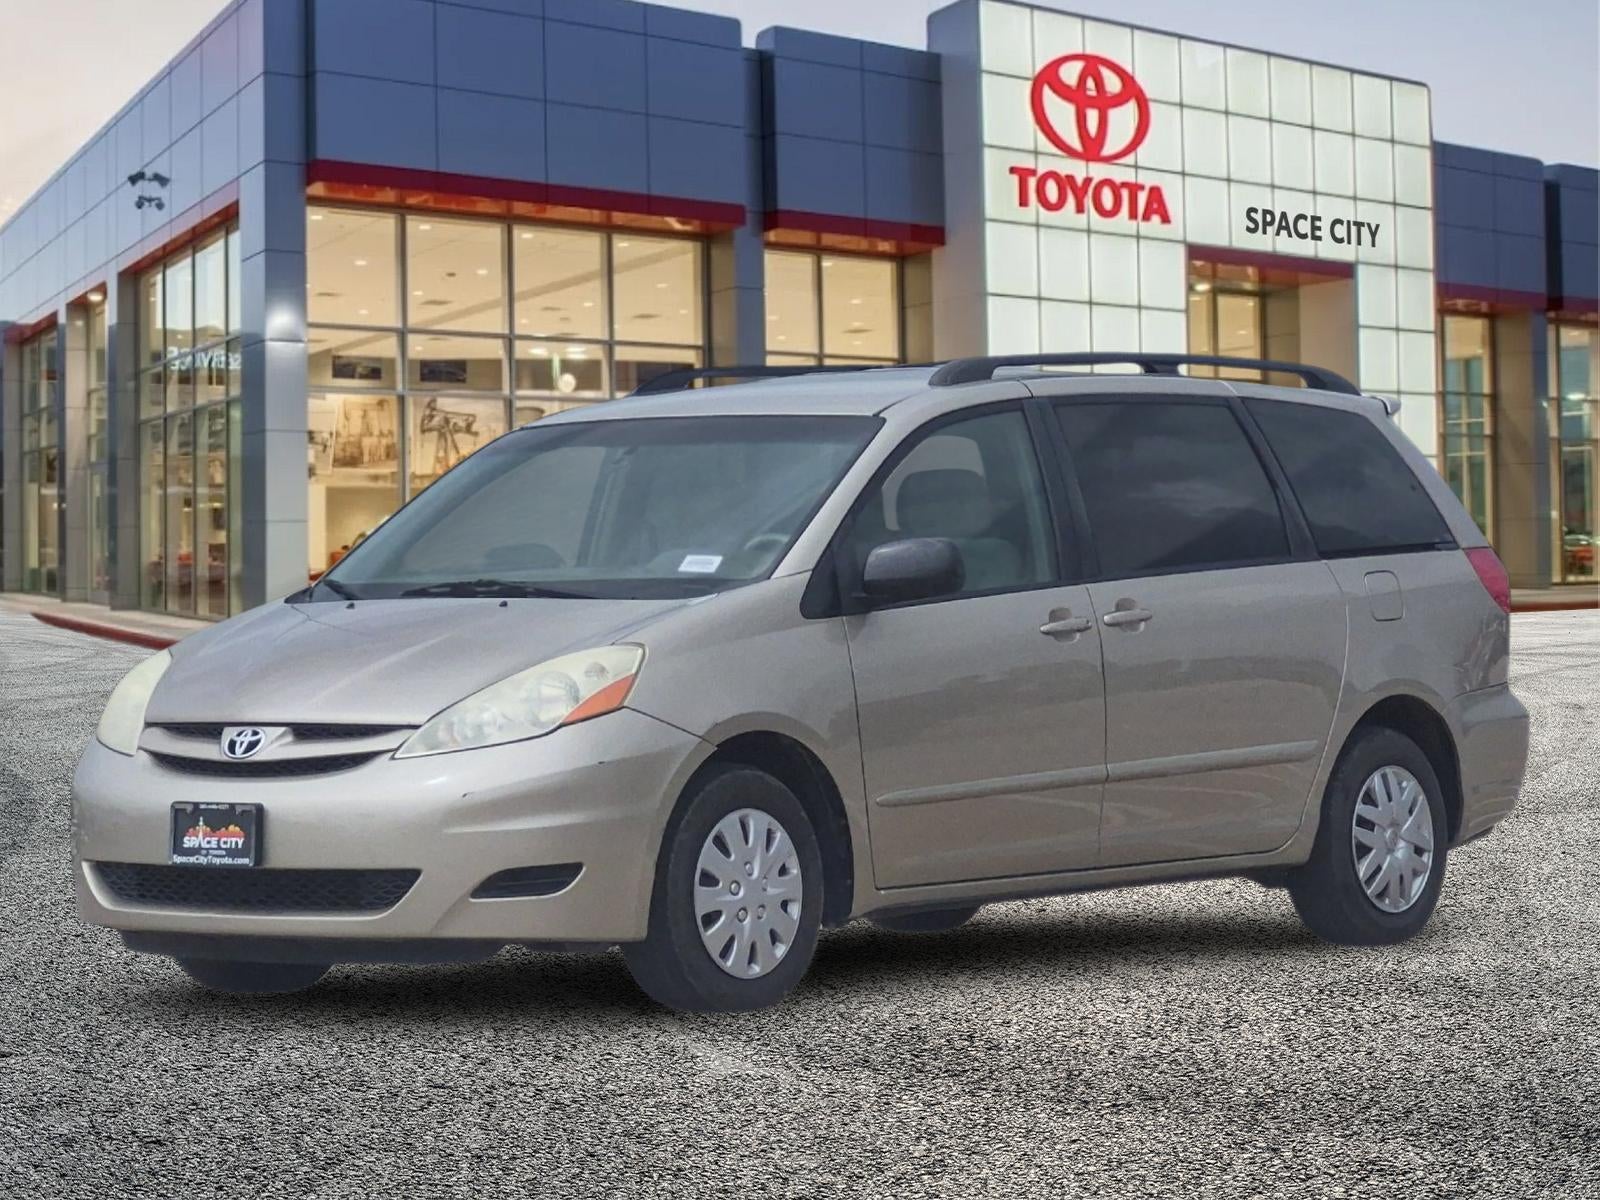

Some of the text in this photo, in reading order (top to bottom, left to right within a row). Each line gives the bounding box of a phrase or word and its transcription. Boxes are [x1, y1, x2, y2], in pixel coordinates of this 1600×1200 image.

[1009, 166, 1171, 224] TOYOTA
[1246, 207, 1380, 247] SPACE CITY
[183, 836, 244, 849] SPACE CITY
[173, 855, 250, 865] SpaceCityToyota.com
